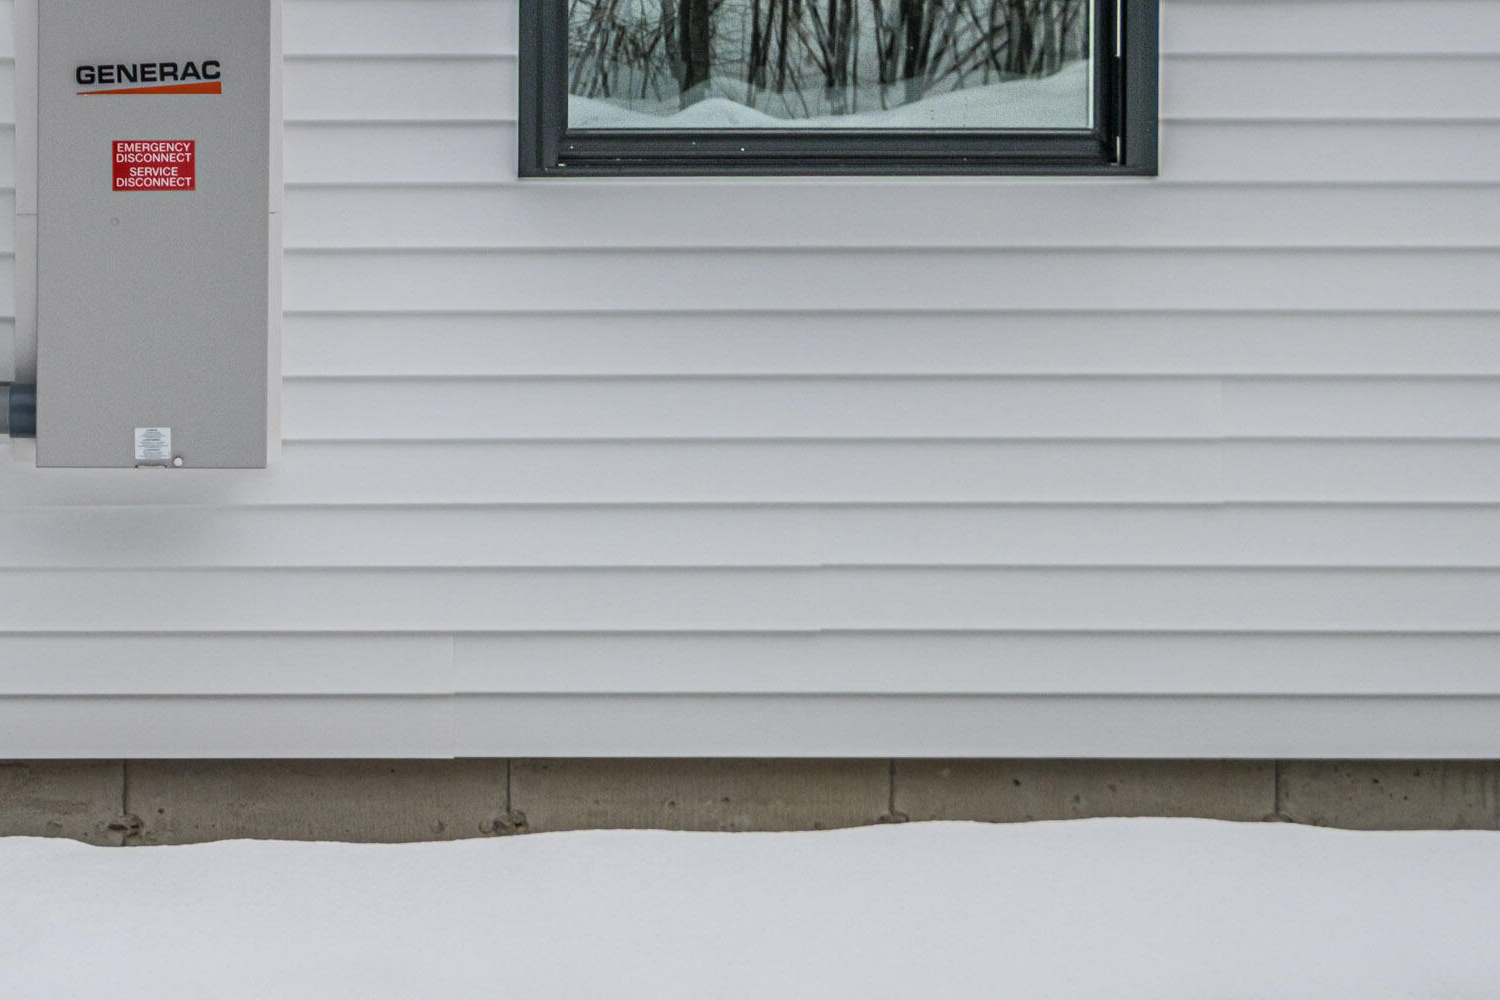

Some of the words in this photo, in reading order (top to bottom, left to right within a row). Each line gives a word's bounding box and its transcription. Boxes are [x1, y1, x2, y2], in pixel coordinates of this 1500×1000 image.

[76, 60, 221, 85] GENERAC
[117, 142, 191, 153] EMERGENCY
[116, 153, 192, 163] DISCONNECT
[129, 166, 179, 177] SERVICE
[116, 177, 192, 187] DISCONNECT
